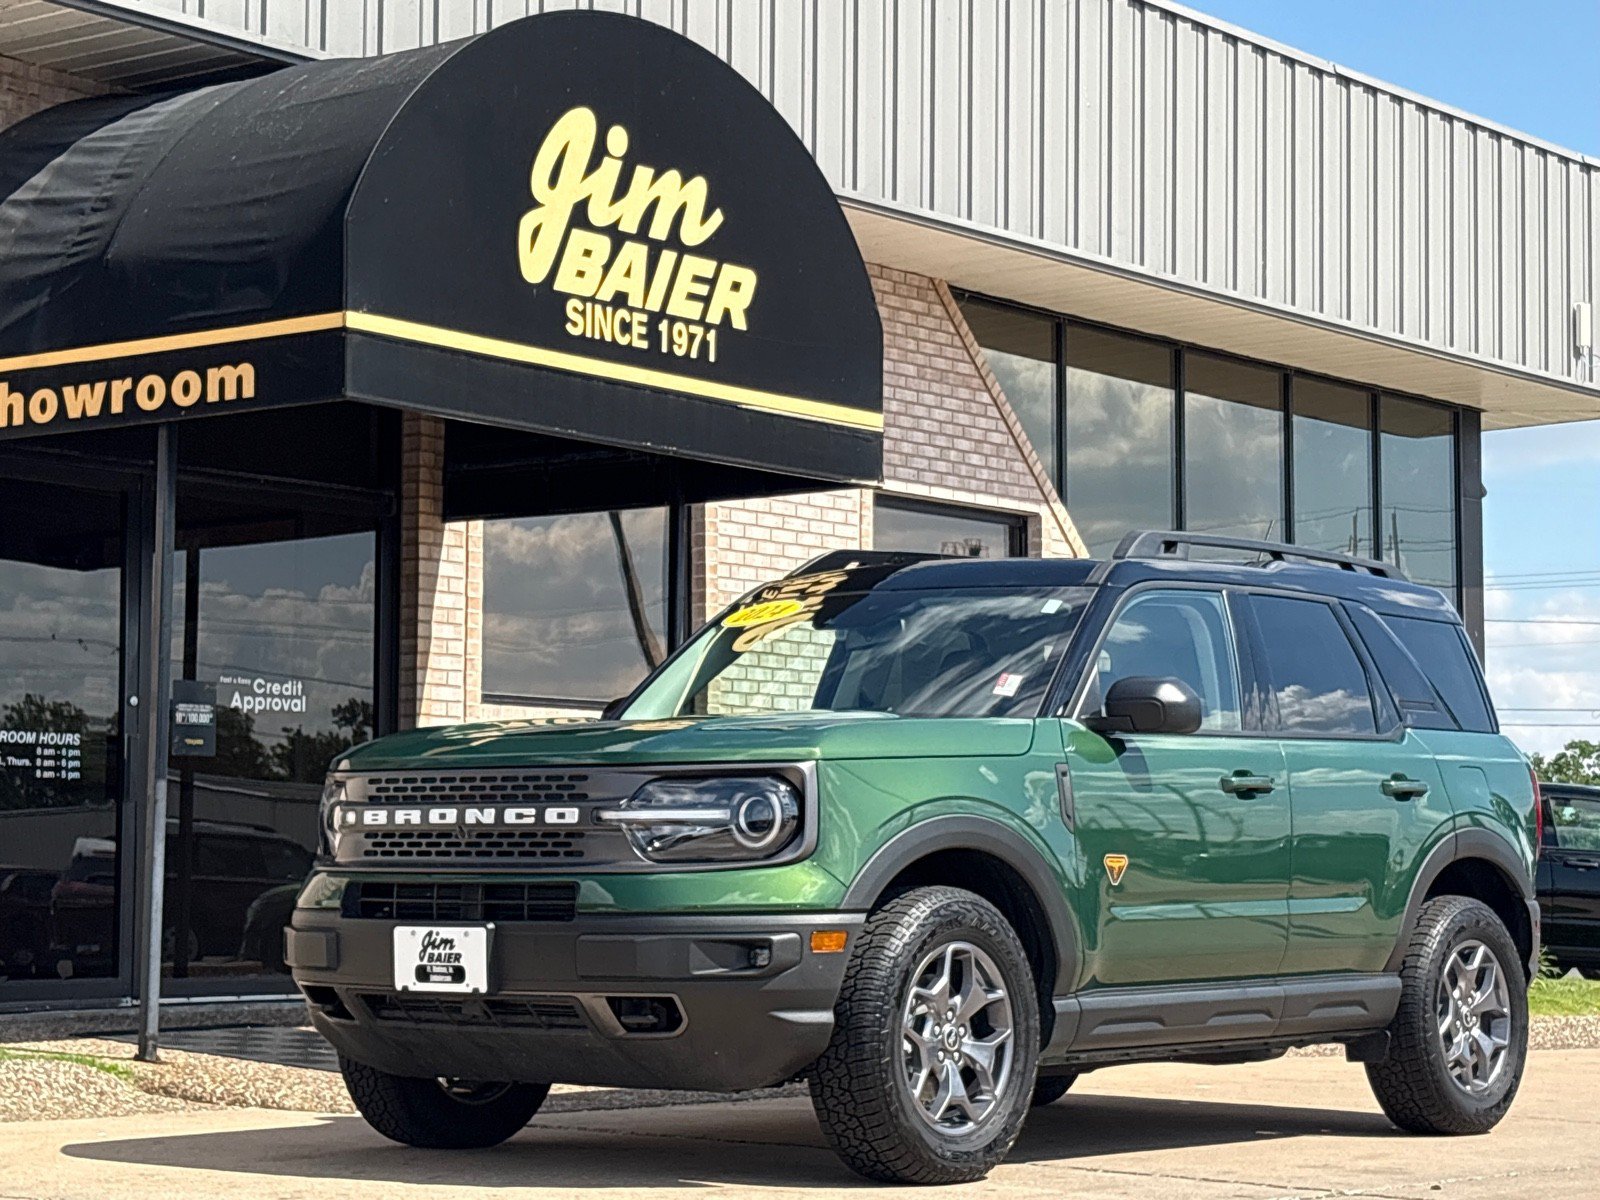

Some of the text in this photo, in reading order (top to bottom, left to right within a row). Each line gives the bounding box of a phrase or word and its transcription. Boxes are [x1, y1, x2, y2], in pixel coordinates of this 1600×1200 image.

[518, 106, 725, 284] Jim
[553, 227, 757, 331] BAIER
[565, 298, 717, 362] SINCE 1971
[253, 678, 303, 696] Credit
[230, 691, 306, 714] Approval
[39, 731, 81, 746] HOURS
[43, 748, 55, 756] am
[68, 749, 80, 758] pm
[6, 756, 32, 767] Thurs.
[68, 760, 80, 769] pm
[42, 771, 55, 779] am
[67, 771, 80, 781] pm
[363, 807, 579, 825] BRONCO
[418, 930, 456, 963] Jim
[427, 952, 463, 964] BAIER
